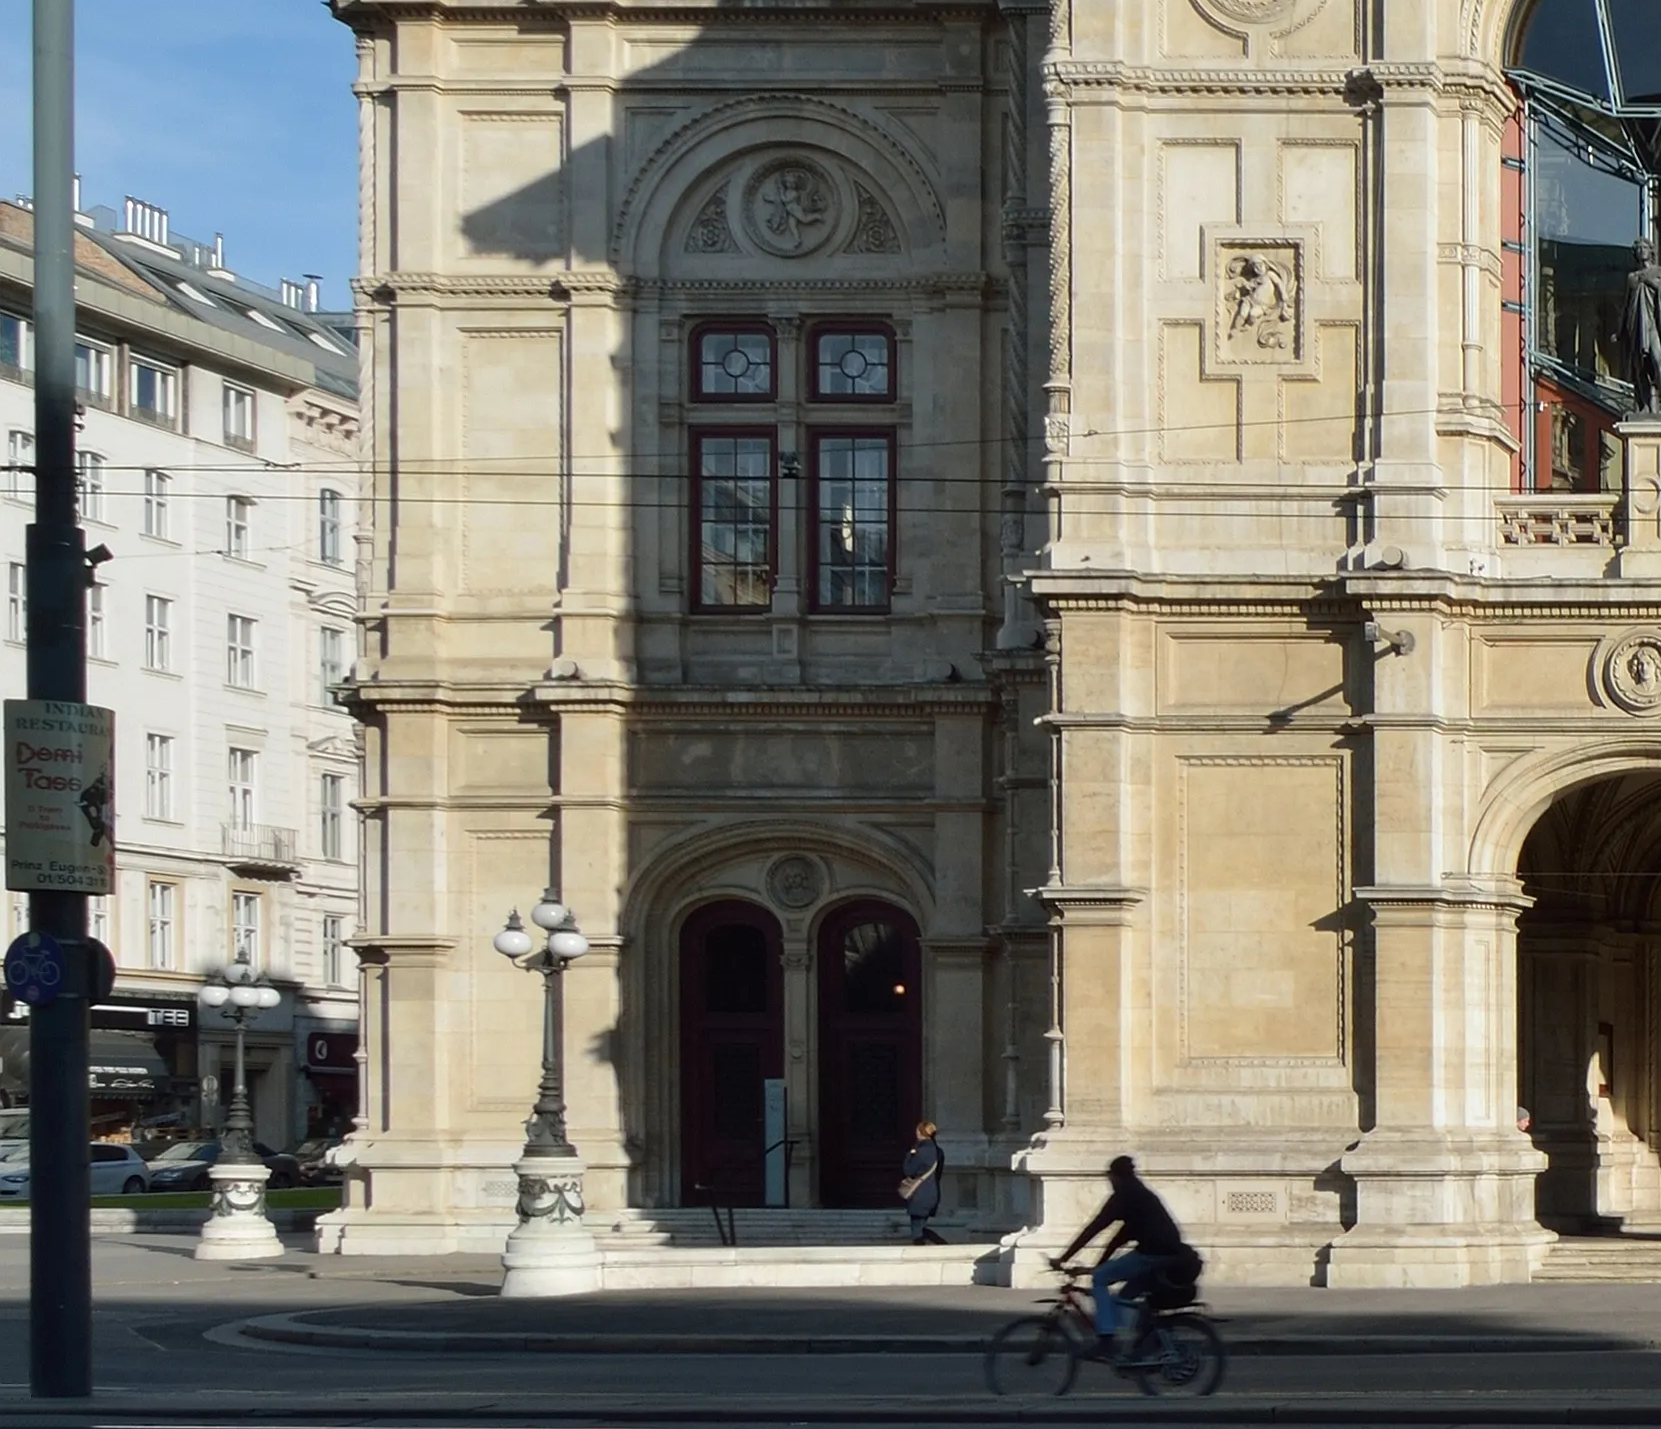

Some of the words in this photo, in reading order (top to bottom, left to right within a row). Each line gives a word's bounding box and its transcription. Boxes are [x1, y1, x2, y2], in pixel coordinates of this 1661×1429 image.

[16, 717, 109, 738] RESTAURA
[16, 741, 84, 764] Demi
[17, 767, 82, 792] Tass
[11, 859, 42, 871] Prinz
[49, 860, 108, 875] Eugen-S
[149, 1008, 188, 1026] TEE
